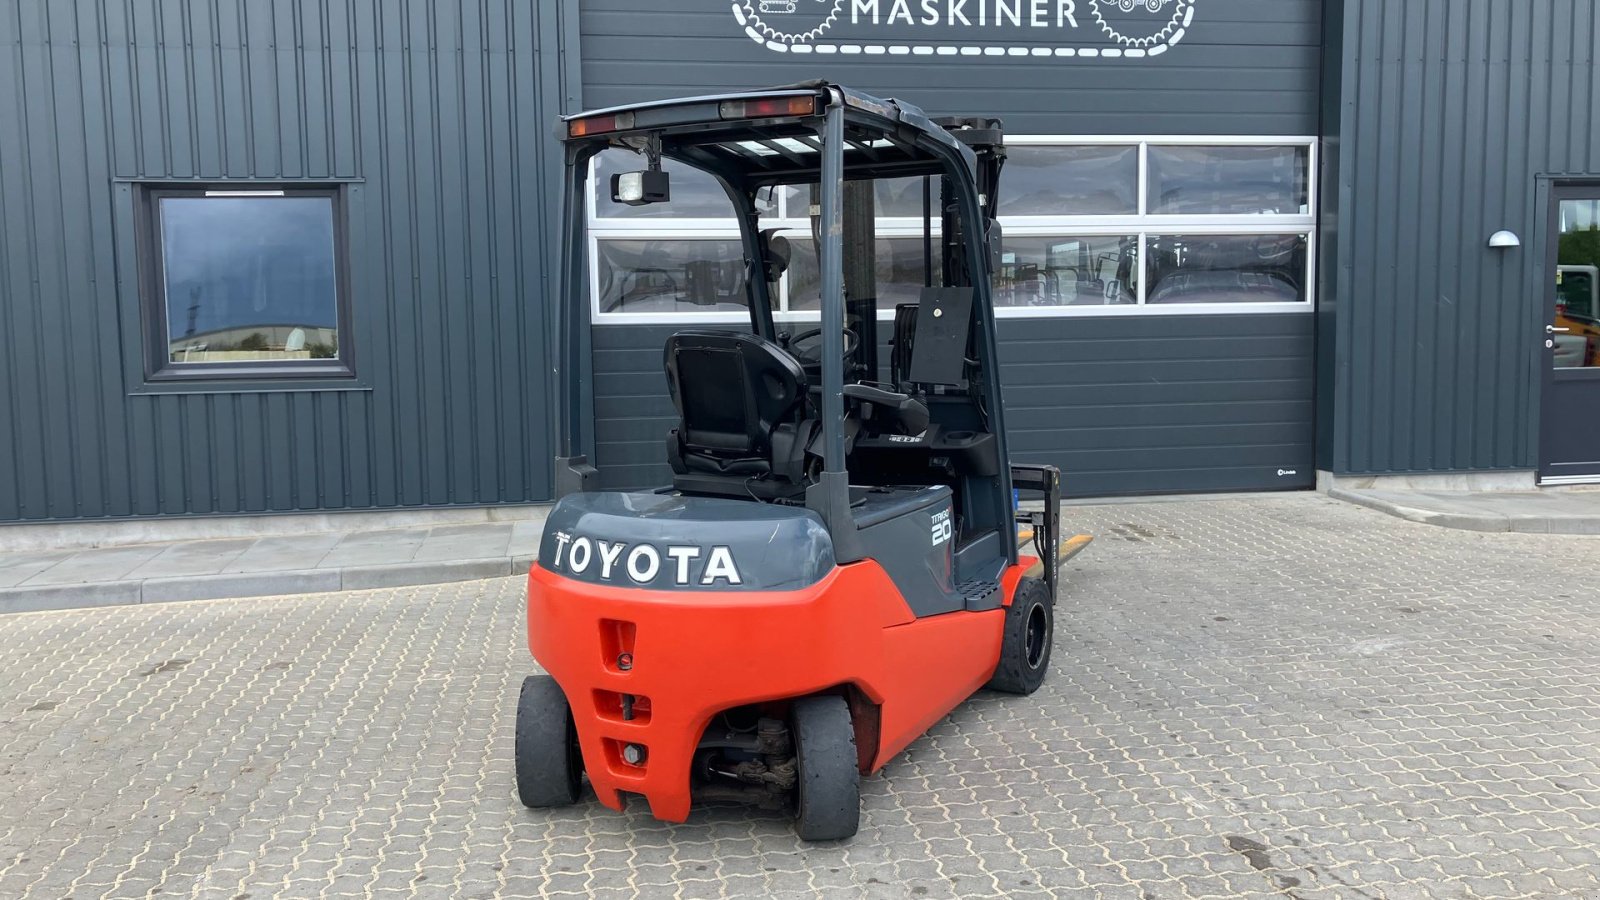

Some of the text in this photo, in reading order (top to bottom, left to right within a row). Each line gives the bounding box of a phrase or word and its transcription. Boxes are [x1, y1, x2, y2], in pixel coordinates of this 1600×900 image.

[851, 0, 1078, 27] MASKINER
[931, 518, 952, 546] 20
[554, 531, 742, 584] TOYOTA
